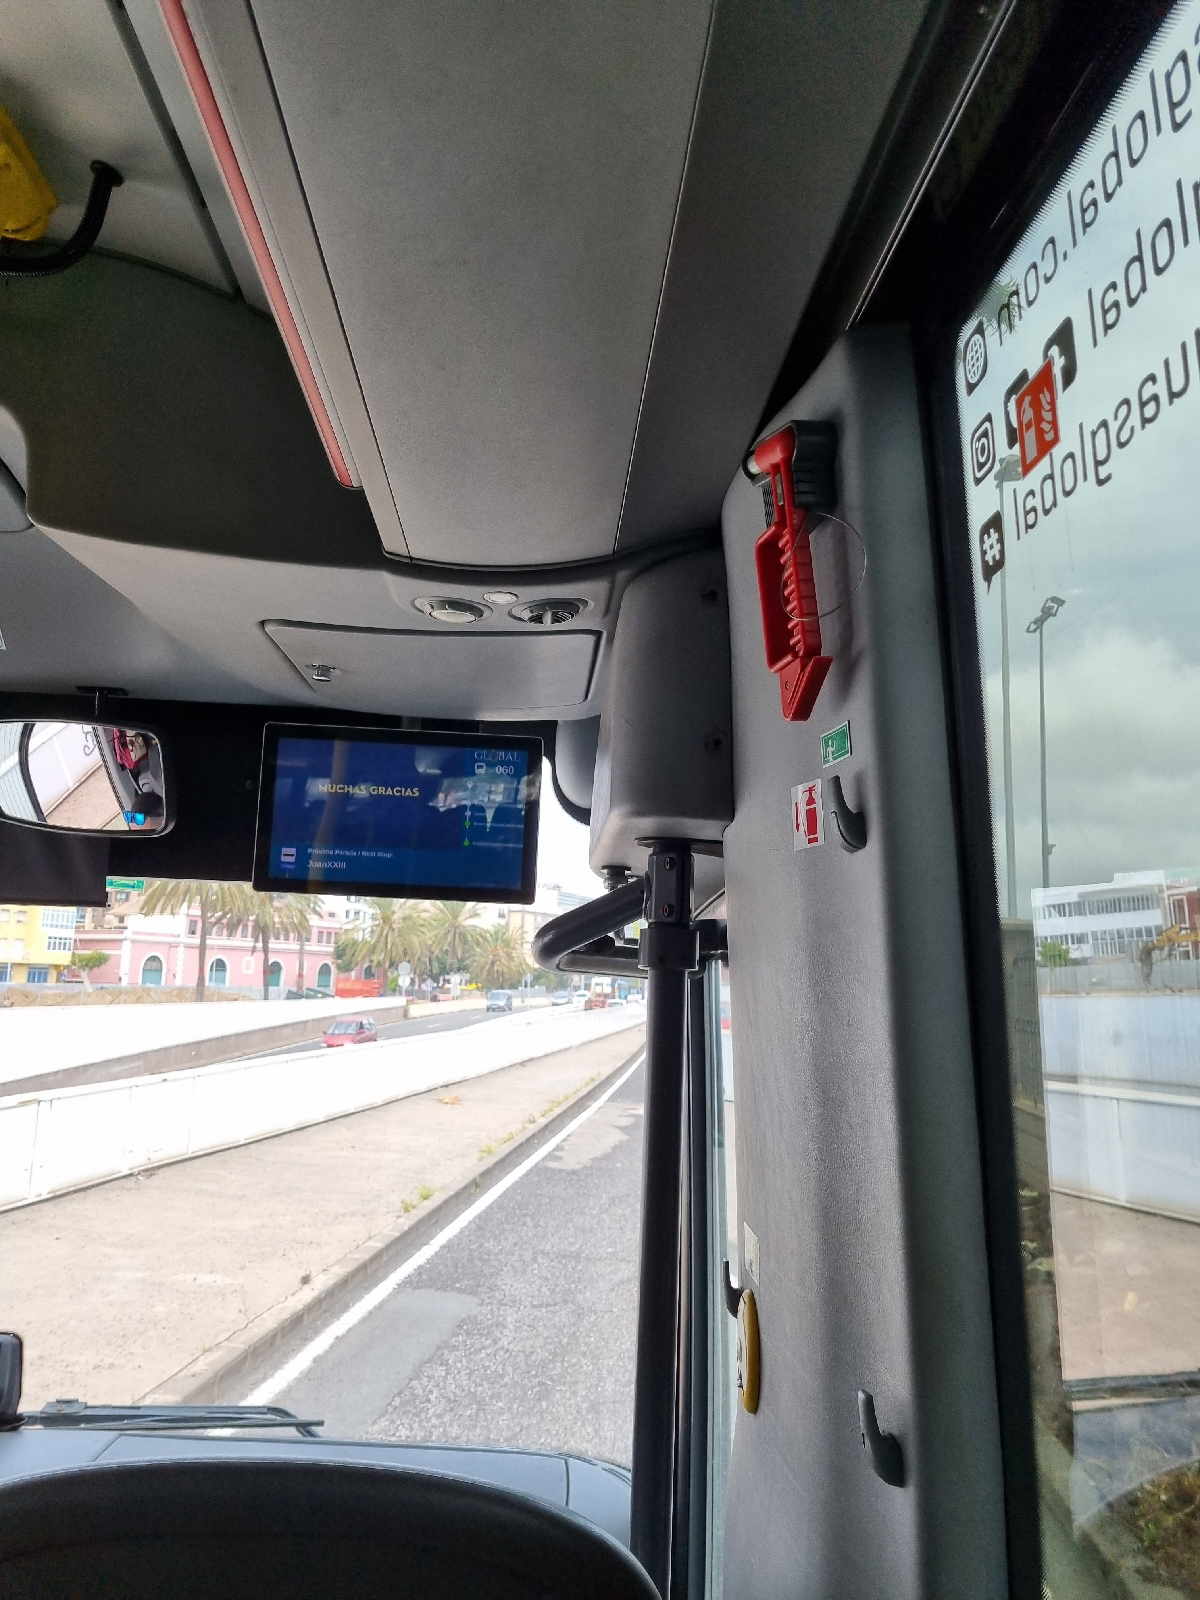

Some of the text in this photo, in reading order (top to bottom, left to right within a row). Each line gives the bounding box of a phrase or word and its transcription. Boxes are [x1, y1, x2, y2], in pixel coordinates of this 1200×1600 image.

[474, 750, 520, 762] GLOBAL
[495, 765, 515, 775] 060
[318, 784, 420, 797] MUCHAS GRACIAS
